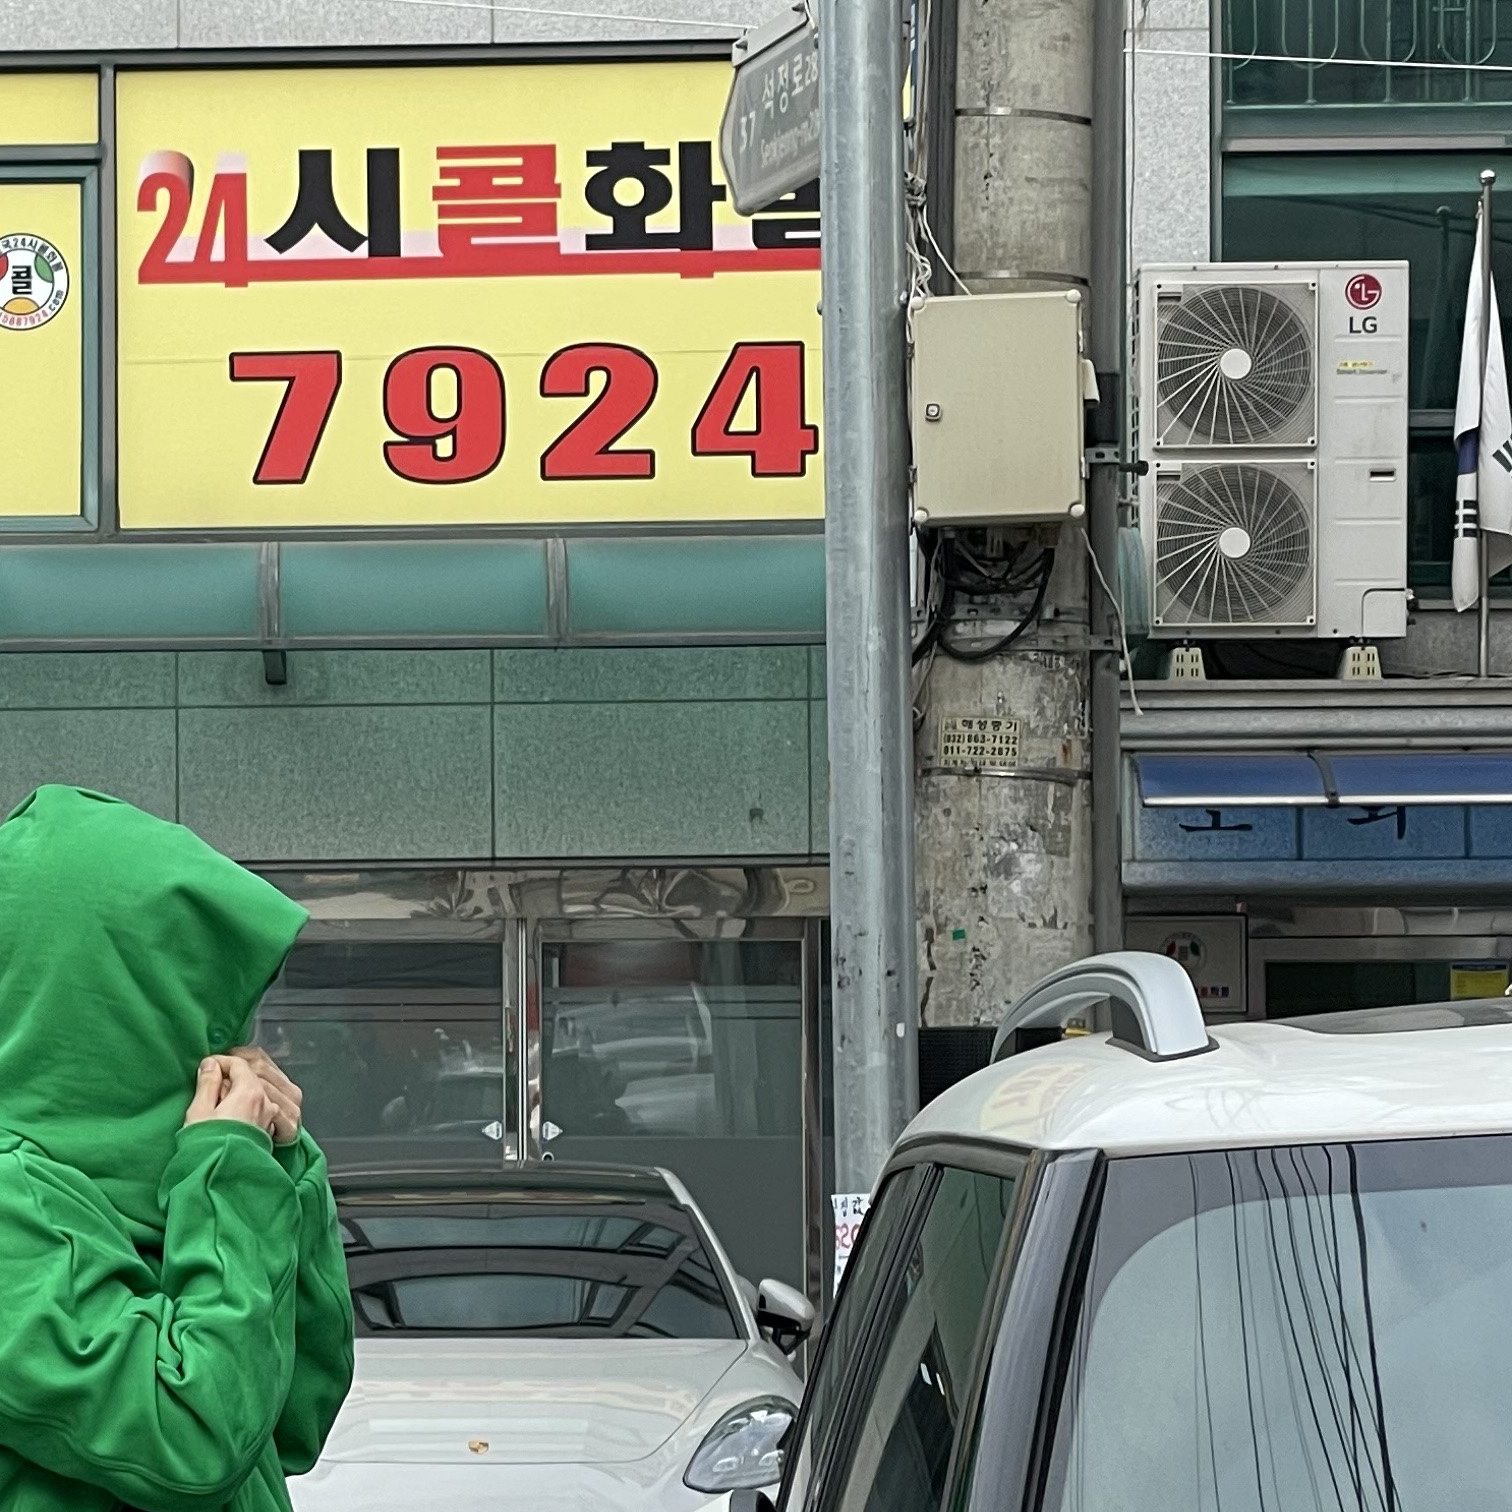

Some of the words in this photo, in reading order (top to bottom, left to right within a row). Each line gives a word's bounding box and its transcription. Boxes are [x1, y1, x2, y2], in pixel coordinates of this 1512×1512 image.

[11, 265, 33, 295] 콜
[1349, 316, 1377, 333] LG
[229, 341, 818, 485] 7924
